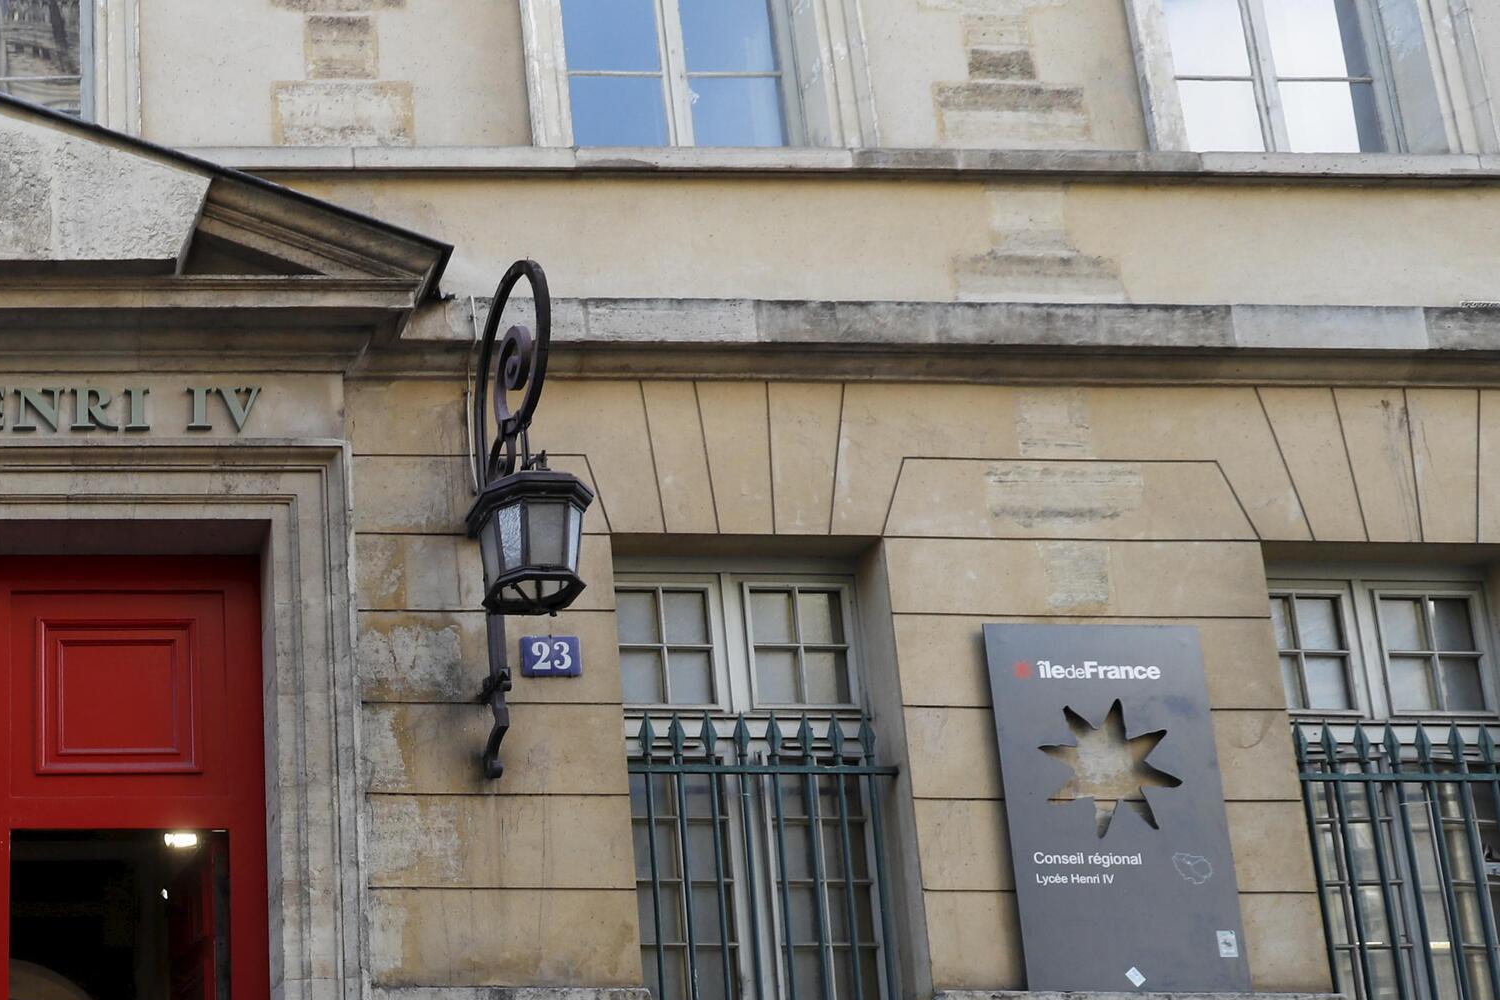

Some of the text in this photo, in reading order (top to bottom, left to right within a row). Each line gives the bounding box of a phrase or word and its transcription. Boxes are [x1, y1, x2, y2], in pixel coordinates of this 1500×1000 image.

[186, 386, 262, 432] IV
[531, 641, 572, 670] 23
[1033, 851, 1142, 868] Conseil régional
[1035, 873, 1115, 886] Lycée Henri IV
